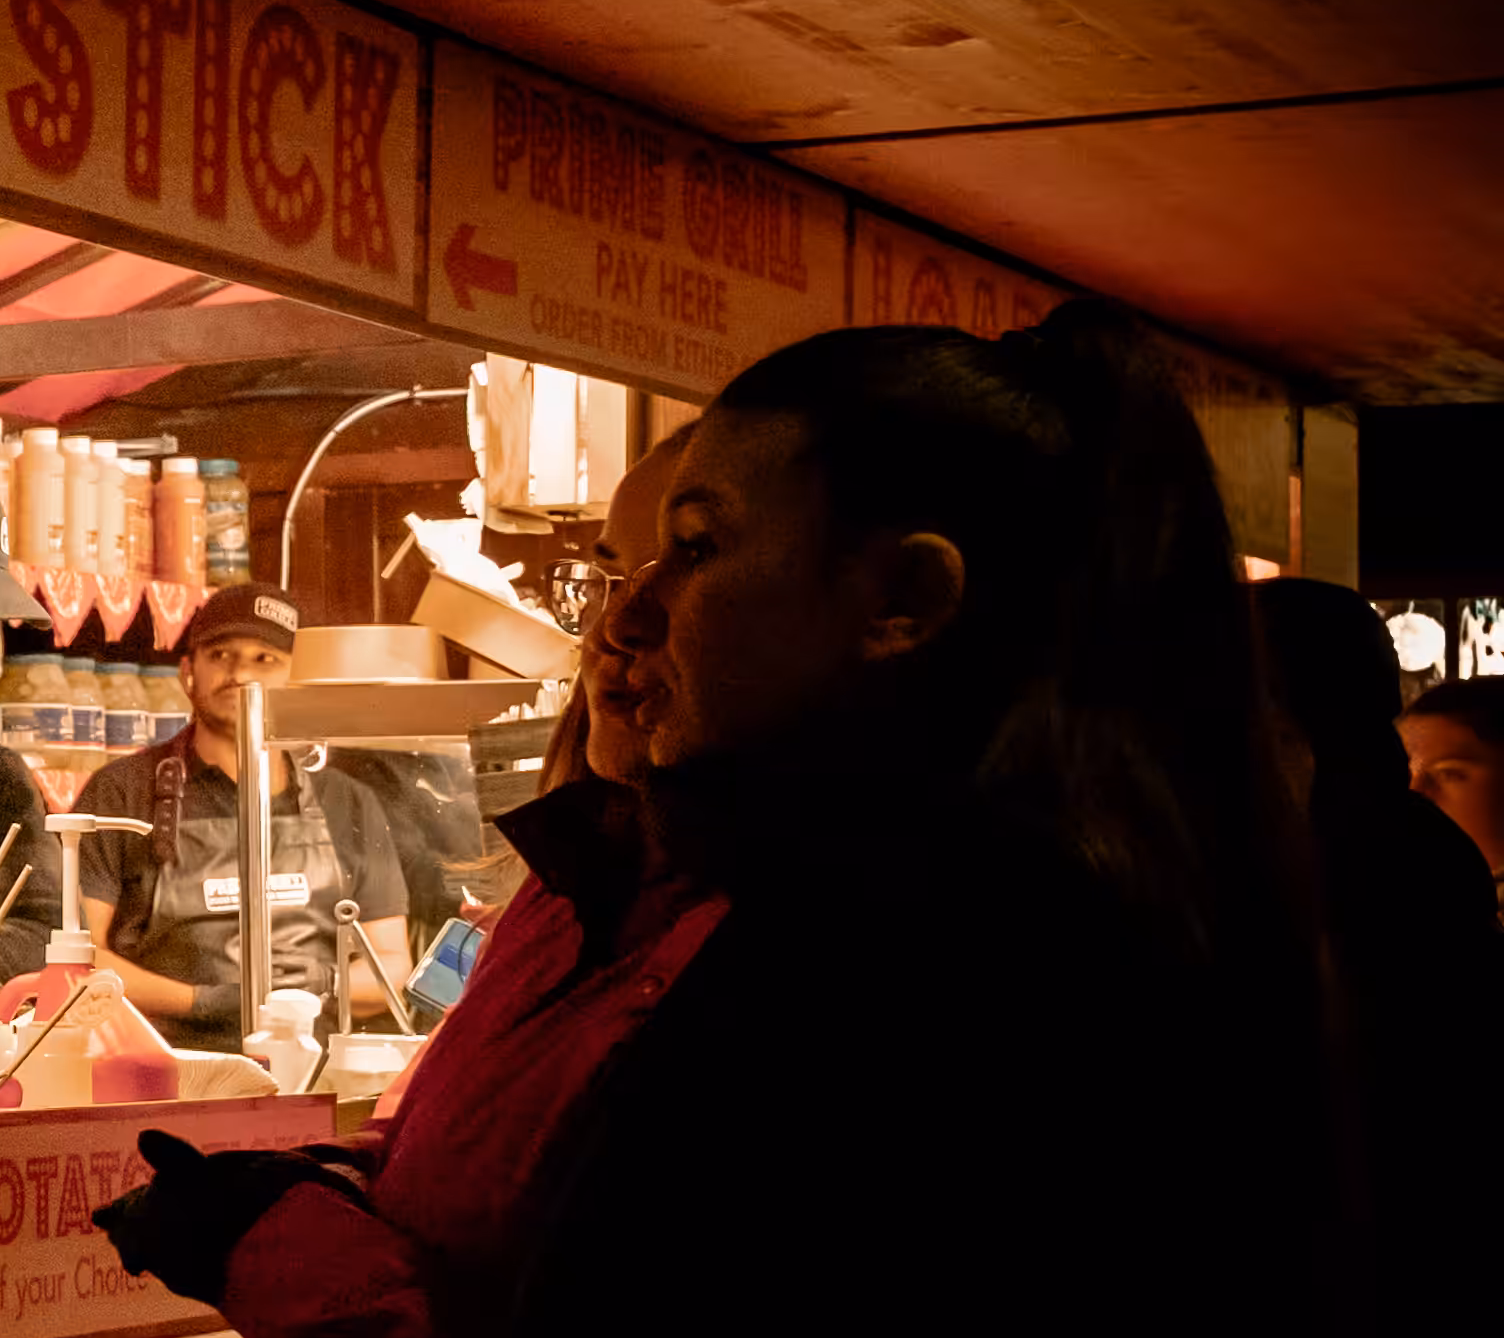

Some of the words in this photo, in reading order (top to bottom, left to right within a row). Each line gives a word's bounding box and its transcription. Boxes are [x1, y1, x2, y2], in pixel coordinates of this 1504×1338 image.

[493, 73, 665, 242] PRIME
[685, 149, 807, 293] GRILL
[529, 292, 603, 350] ORDER
[610, 317, 667, 364] FROM
[595, 239, 651, 307] PAY
[659, 263, 729, 335] HERE
[14, 1270, 65, 1322] your
